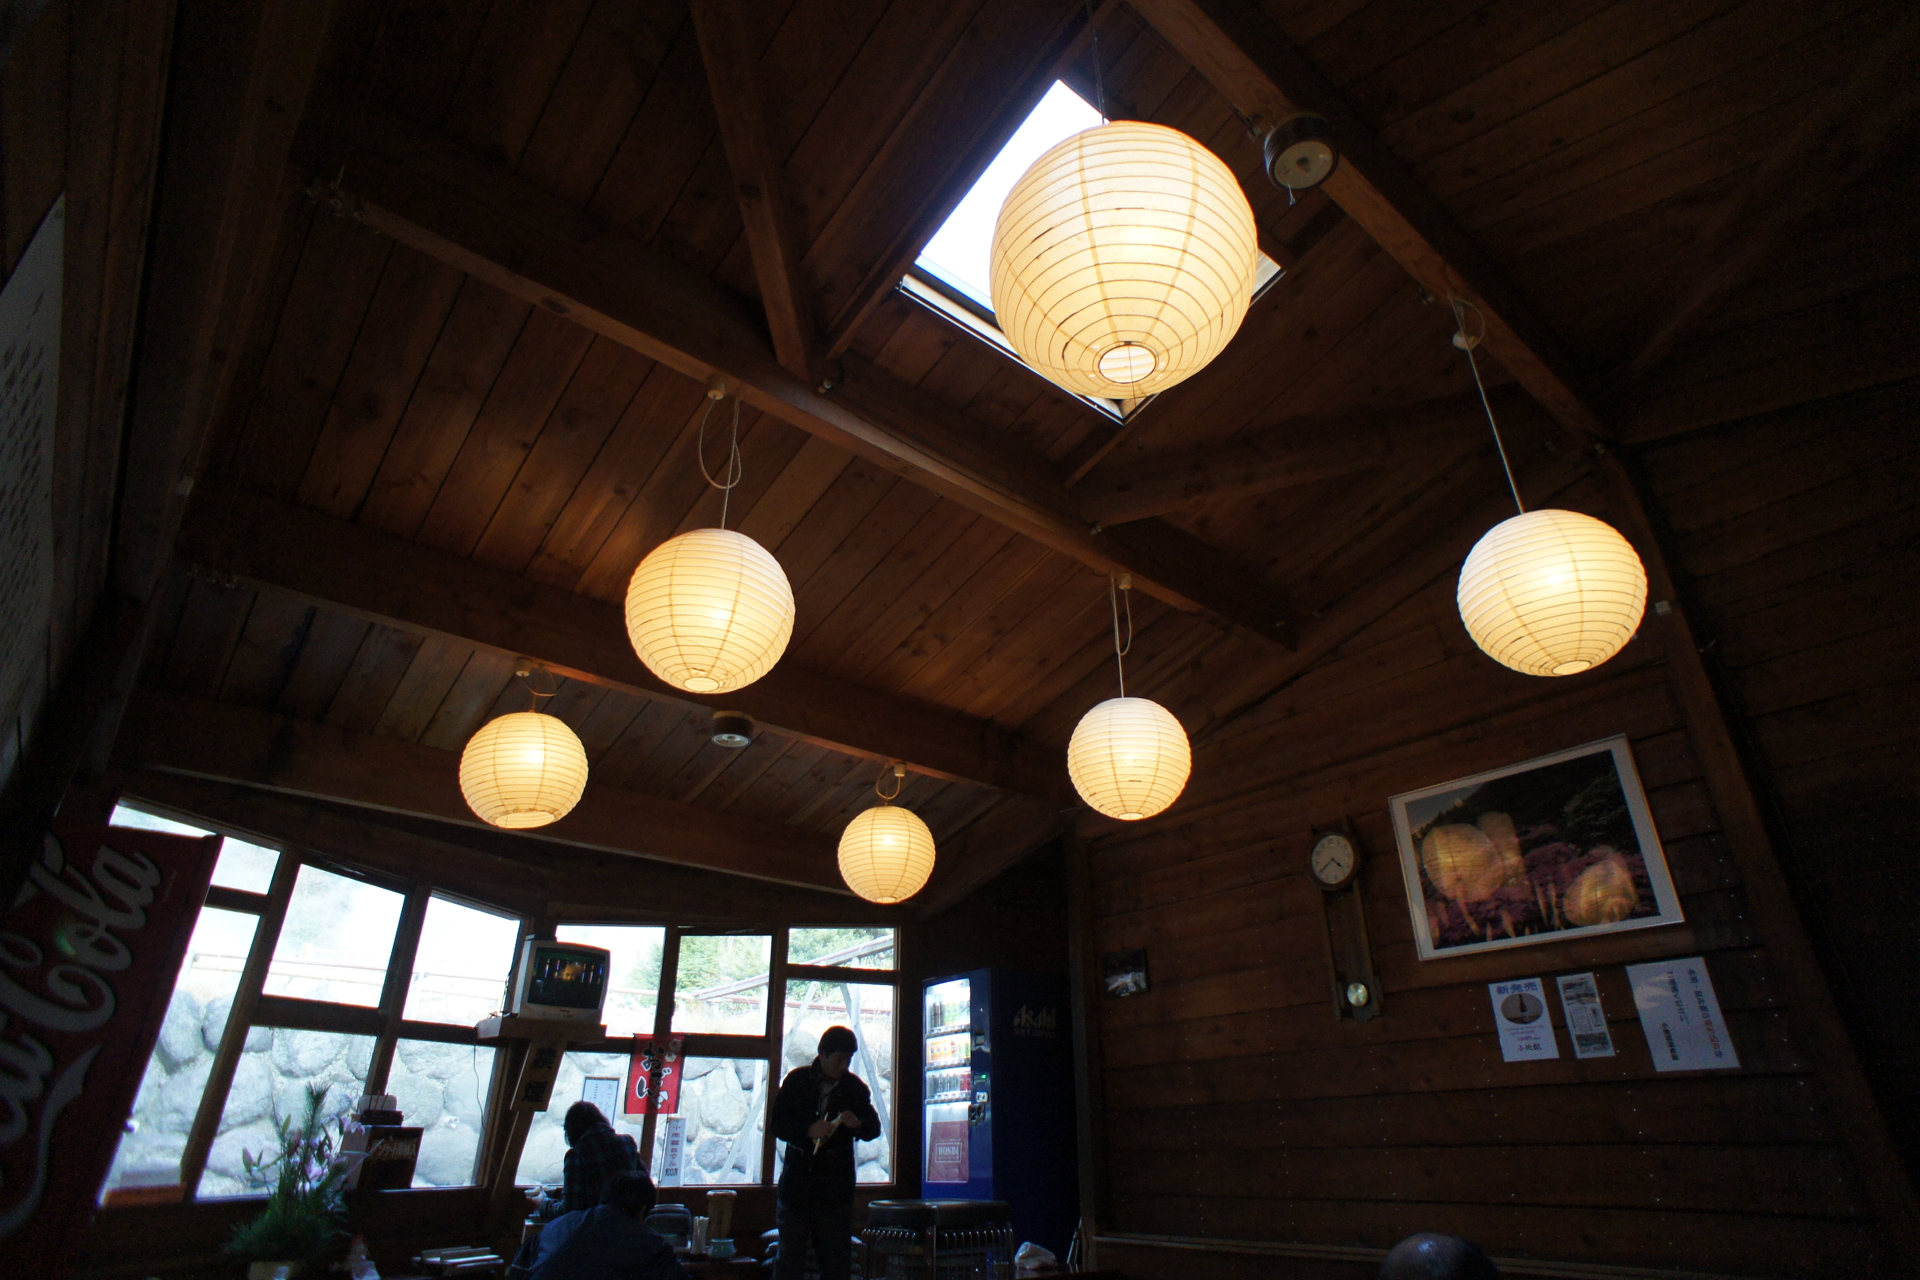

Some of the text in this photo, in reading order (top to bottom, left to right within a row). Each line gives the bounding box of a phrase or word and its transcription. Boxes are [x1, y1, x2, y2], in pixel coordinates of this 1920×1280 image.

[1496, 981, 1538, 995] 新発売
[1013, 1004, 1057, 1030] Asahi
[636, 1041, 672, 1098] おでん
[938, 1146, 959, 1156] WONDA
